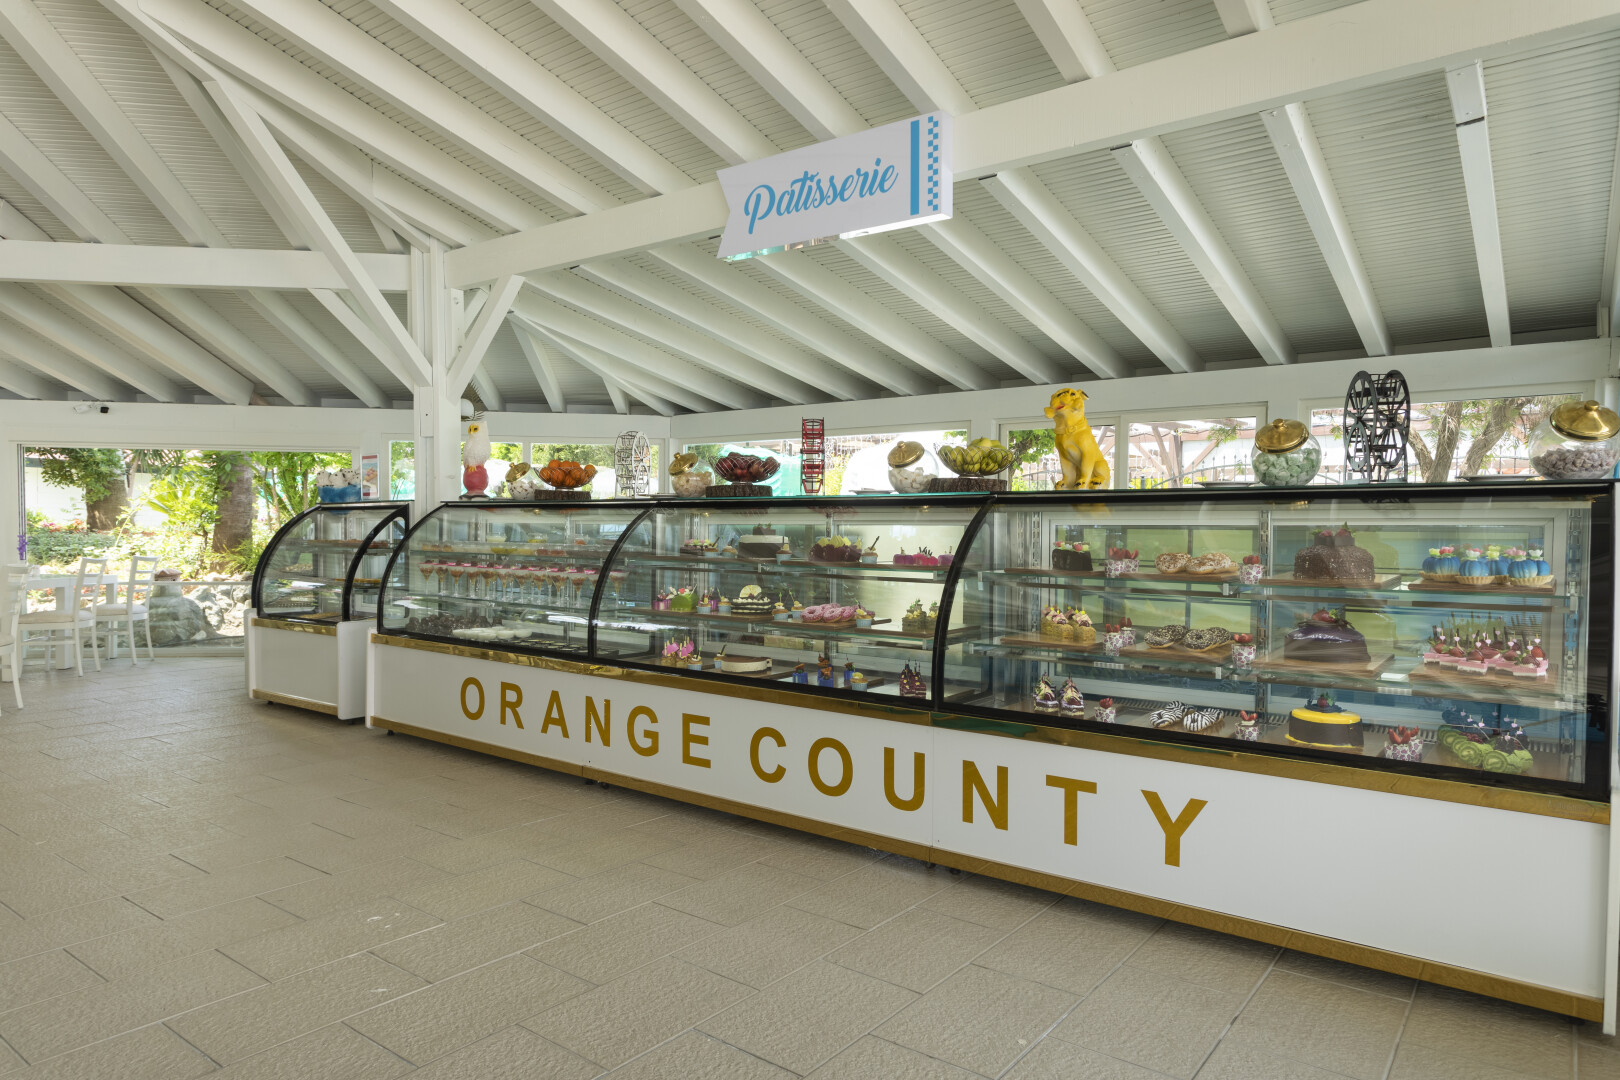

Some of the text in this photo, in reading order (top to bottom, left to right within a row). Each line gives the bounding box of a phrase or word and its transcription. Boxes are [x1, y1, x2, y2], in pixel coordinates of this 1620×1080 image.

[744, 157, 899, 235] Patisserie
[460, 676, 1207, 867] ORANGE COUNTY
